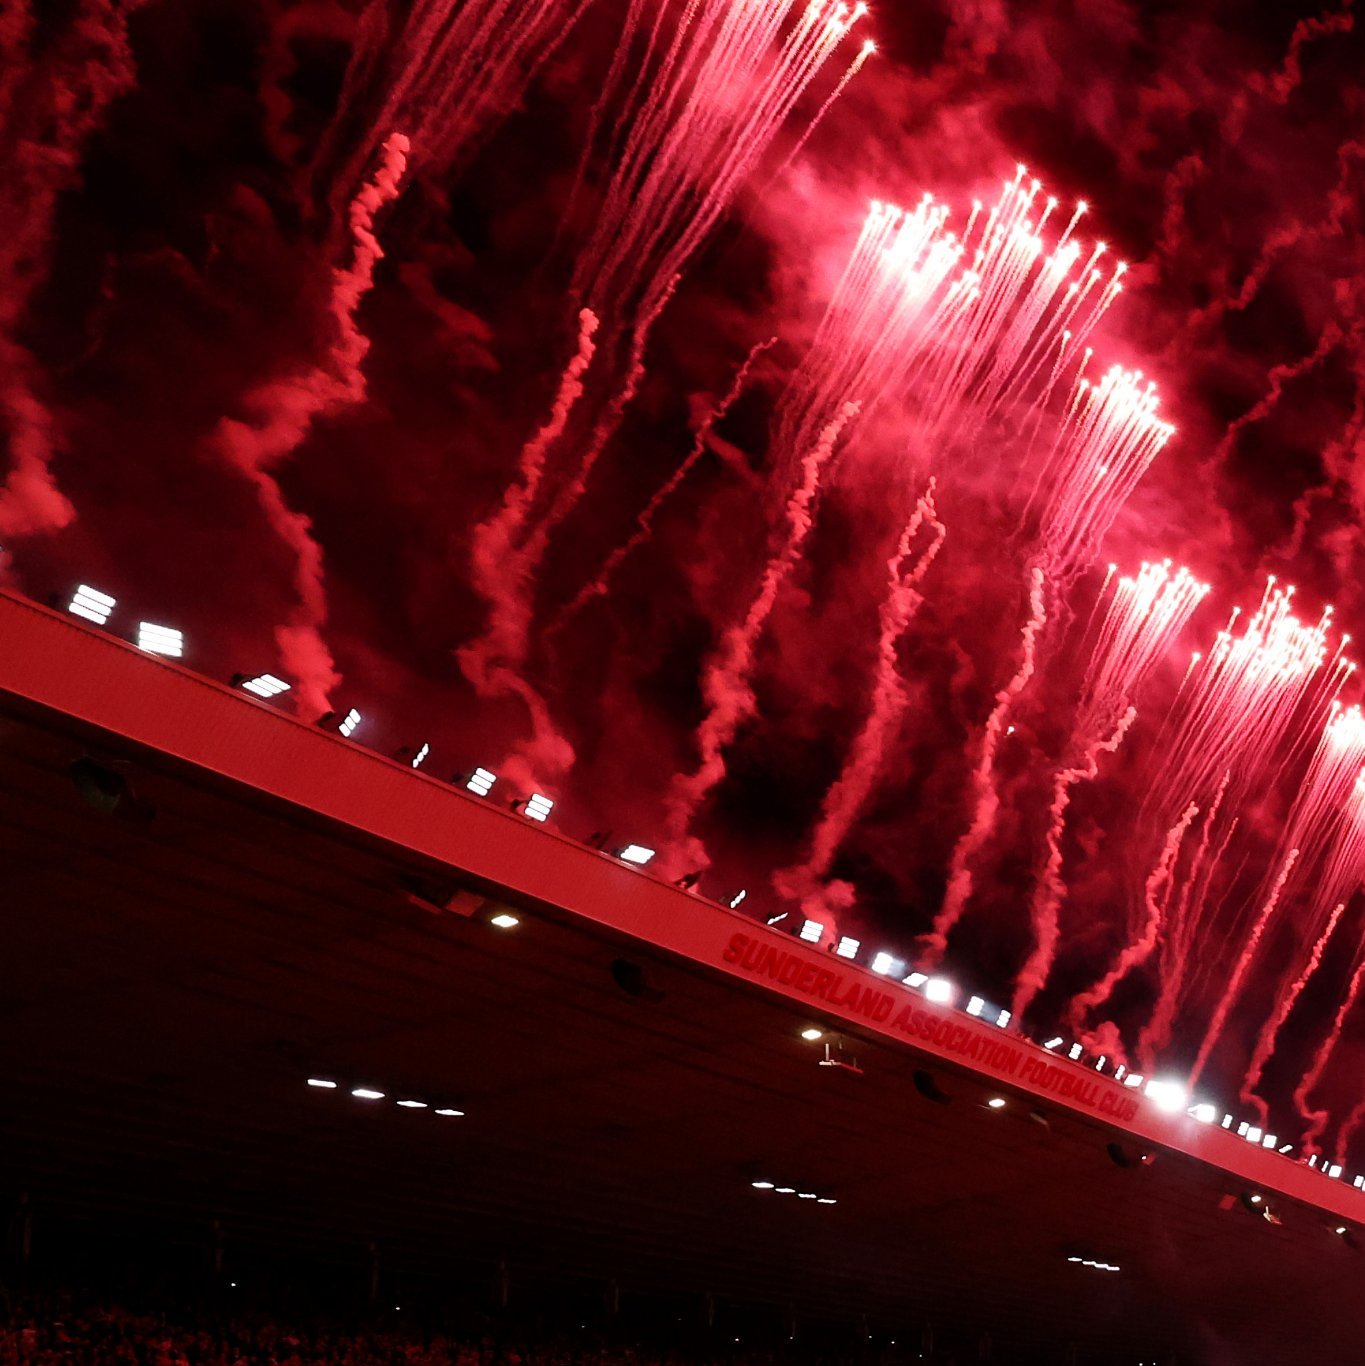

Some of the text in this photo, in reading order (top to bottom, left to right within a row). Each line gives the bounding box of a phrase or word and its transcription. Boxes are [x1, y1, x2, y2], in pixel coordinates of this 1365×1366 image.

[723, 933, 1140, 1121] SUNDERLAND ASSOCIATION FOOTBALL CLUB
